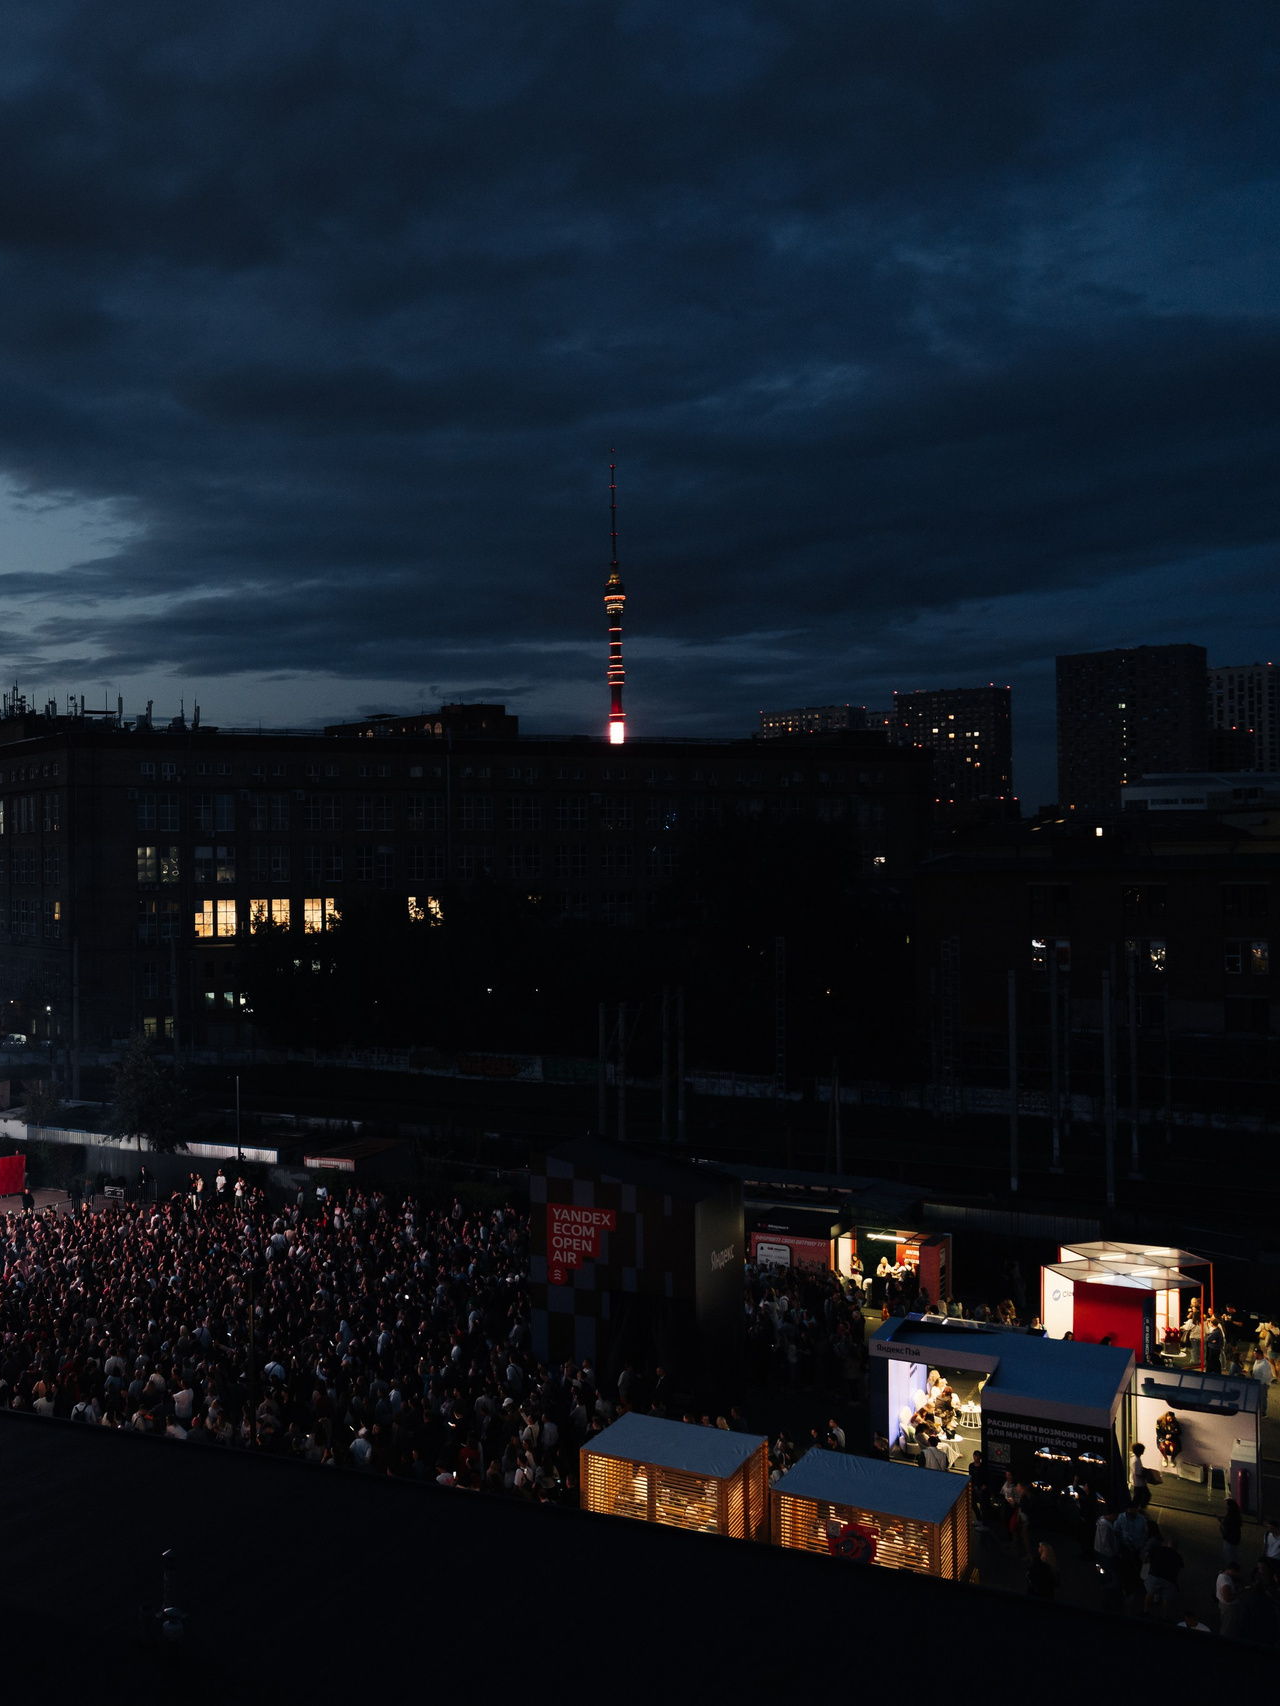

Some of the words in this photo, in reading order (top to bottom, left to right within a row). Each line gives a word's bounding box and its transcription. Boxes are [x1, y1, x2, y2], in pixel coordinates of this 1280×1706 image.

[552, 1207, 611, 1227] YANDEX
[553, 1222, 595, 1238] ECOM
[552, 1236, 592, 1252] OPEN
[552, 1250, 577, 1264] AIR
[710, 1243, 735, 1272] Яндекс
[876, 1343, 904, 1355] Яндекс
[905, 1347, 920, 1357] Пэй
[987, 1418, 1037, 1433] РАСШИРЯЕМ
[1039, 1426, 1104, 1444] ВОЗМОЖНОСТИ
[987, 1427, 1005, 1438] ДЛЯ
[1005, 1431, 1078, 1449] МАРКЕТПЛЕЙСОВ
